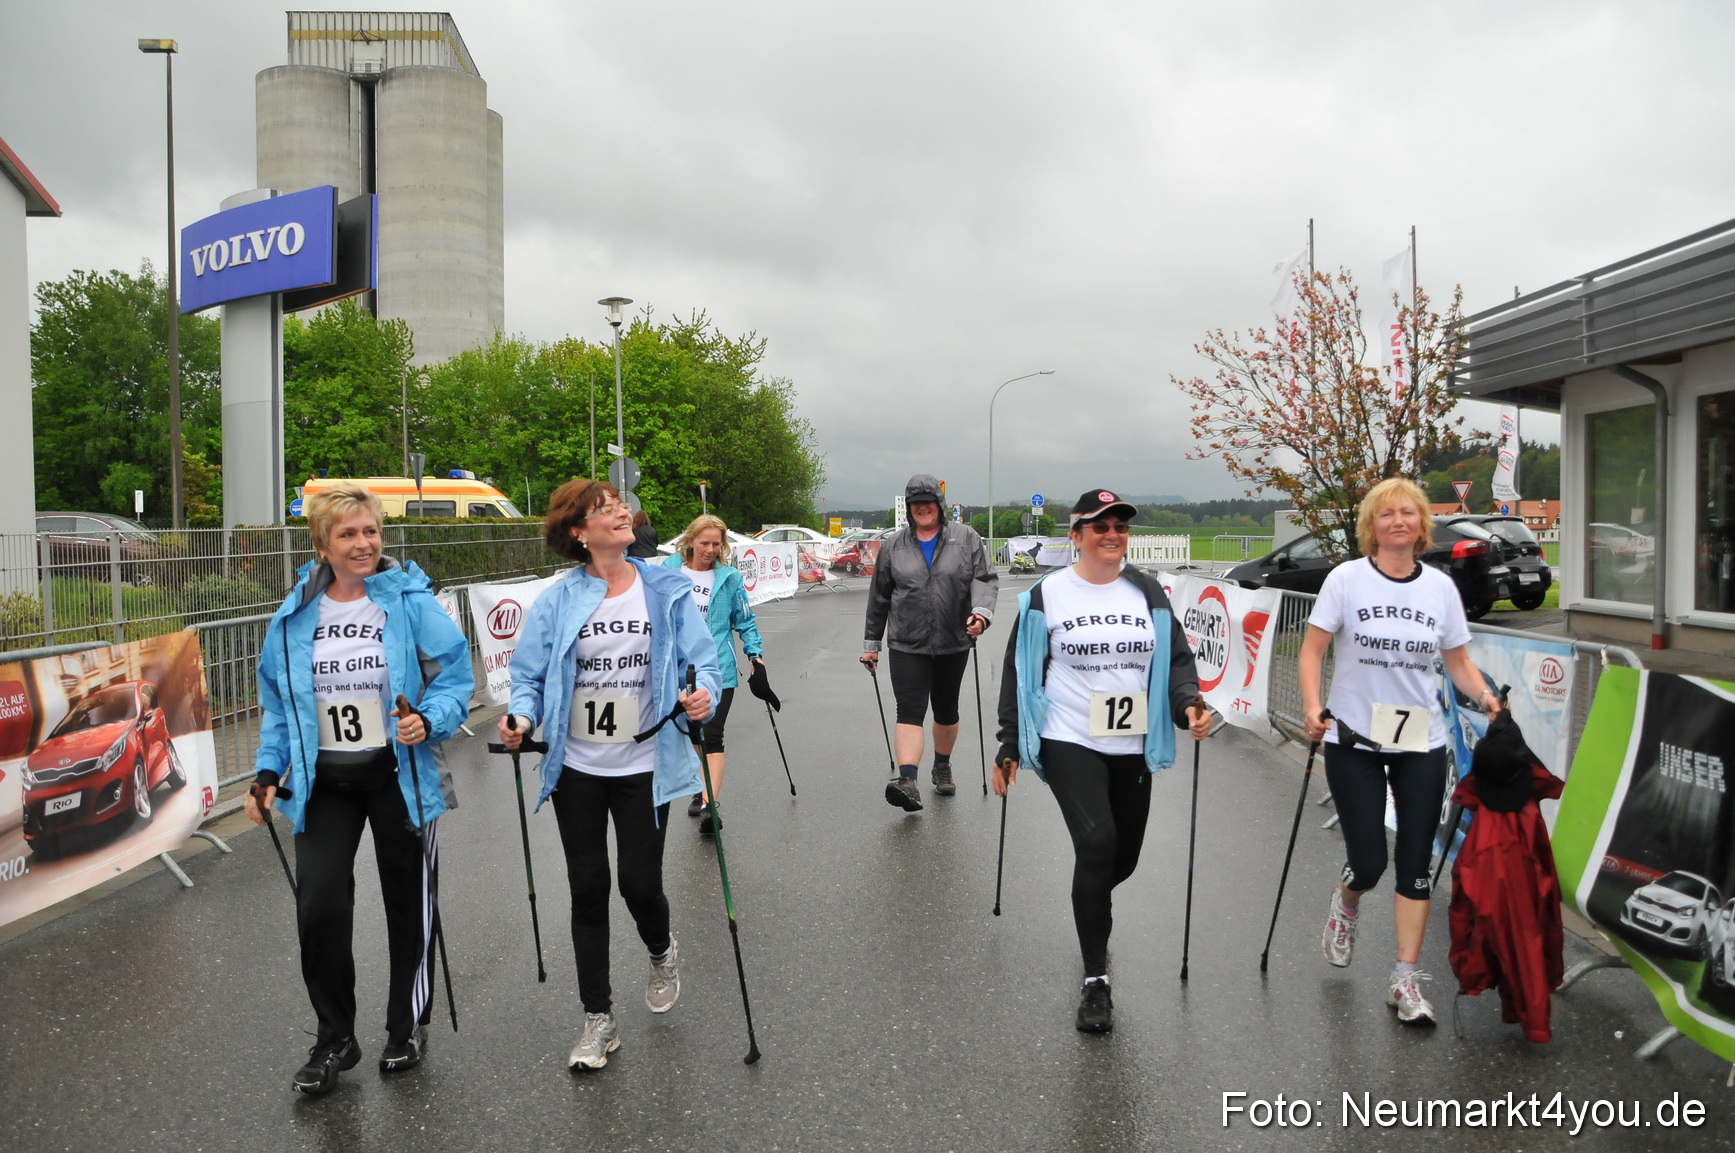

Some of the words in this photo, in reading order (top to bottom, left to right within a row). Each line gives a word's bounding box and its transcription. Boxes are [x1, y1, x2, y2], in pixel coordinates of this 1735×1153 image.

[190, 222, 305, 277] VOLVO
[493, 608, 518, 631] KIA
[1062, 614, 1148, 632] BERGER
[1356, 605, 1436, 631] BERGER
[313, 623, 384, 643] ERGER
[578, 620, 652, 640] ERGER
[1061, 641, 1111, 655] POWER
[1354, 632, 1401, 652] POWER
[576, 658, 612, 672] OWER
[618, 652, 651, 670] GIRL
[1070, 663, 1101, 673] walking
[1103, 662, 1118, 671] and
[1120, 662, 1146, 673] talking
[1358, 657, 1389, 669] walking
[1406, 661, 1428, 672] talking
[1540, 663, 1558, 680] KIA
[313, 683, 332, 694] king
[335, 682, 351, 692] and
[353, 681, 384, 692] talking
[601, 680, 618, 689] and
[621, 680, 646, 689] talking
[11, 693, 25, 706] AUF
[585, 700, 617, 737] 14
[1105, 696, 1134, 730] 12
[327, 704, 363, 743] 13
[1392, 709, 1411, 744] 7
[1659, 741, 1726, 793] UNSER
[52, 798, 73, 810] RIO
